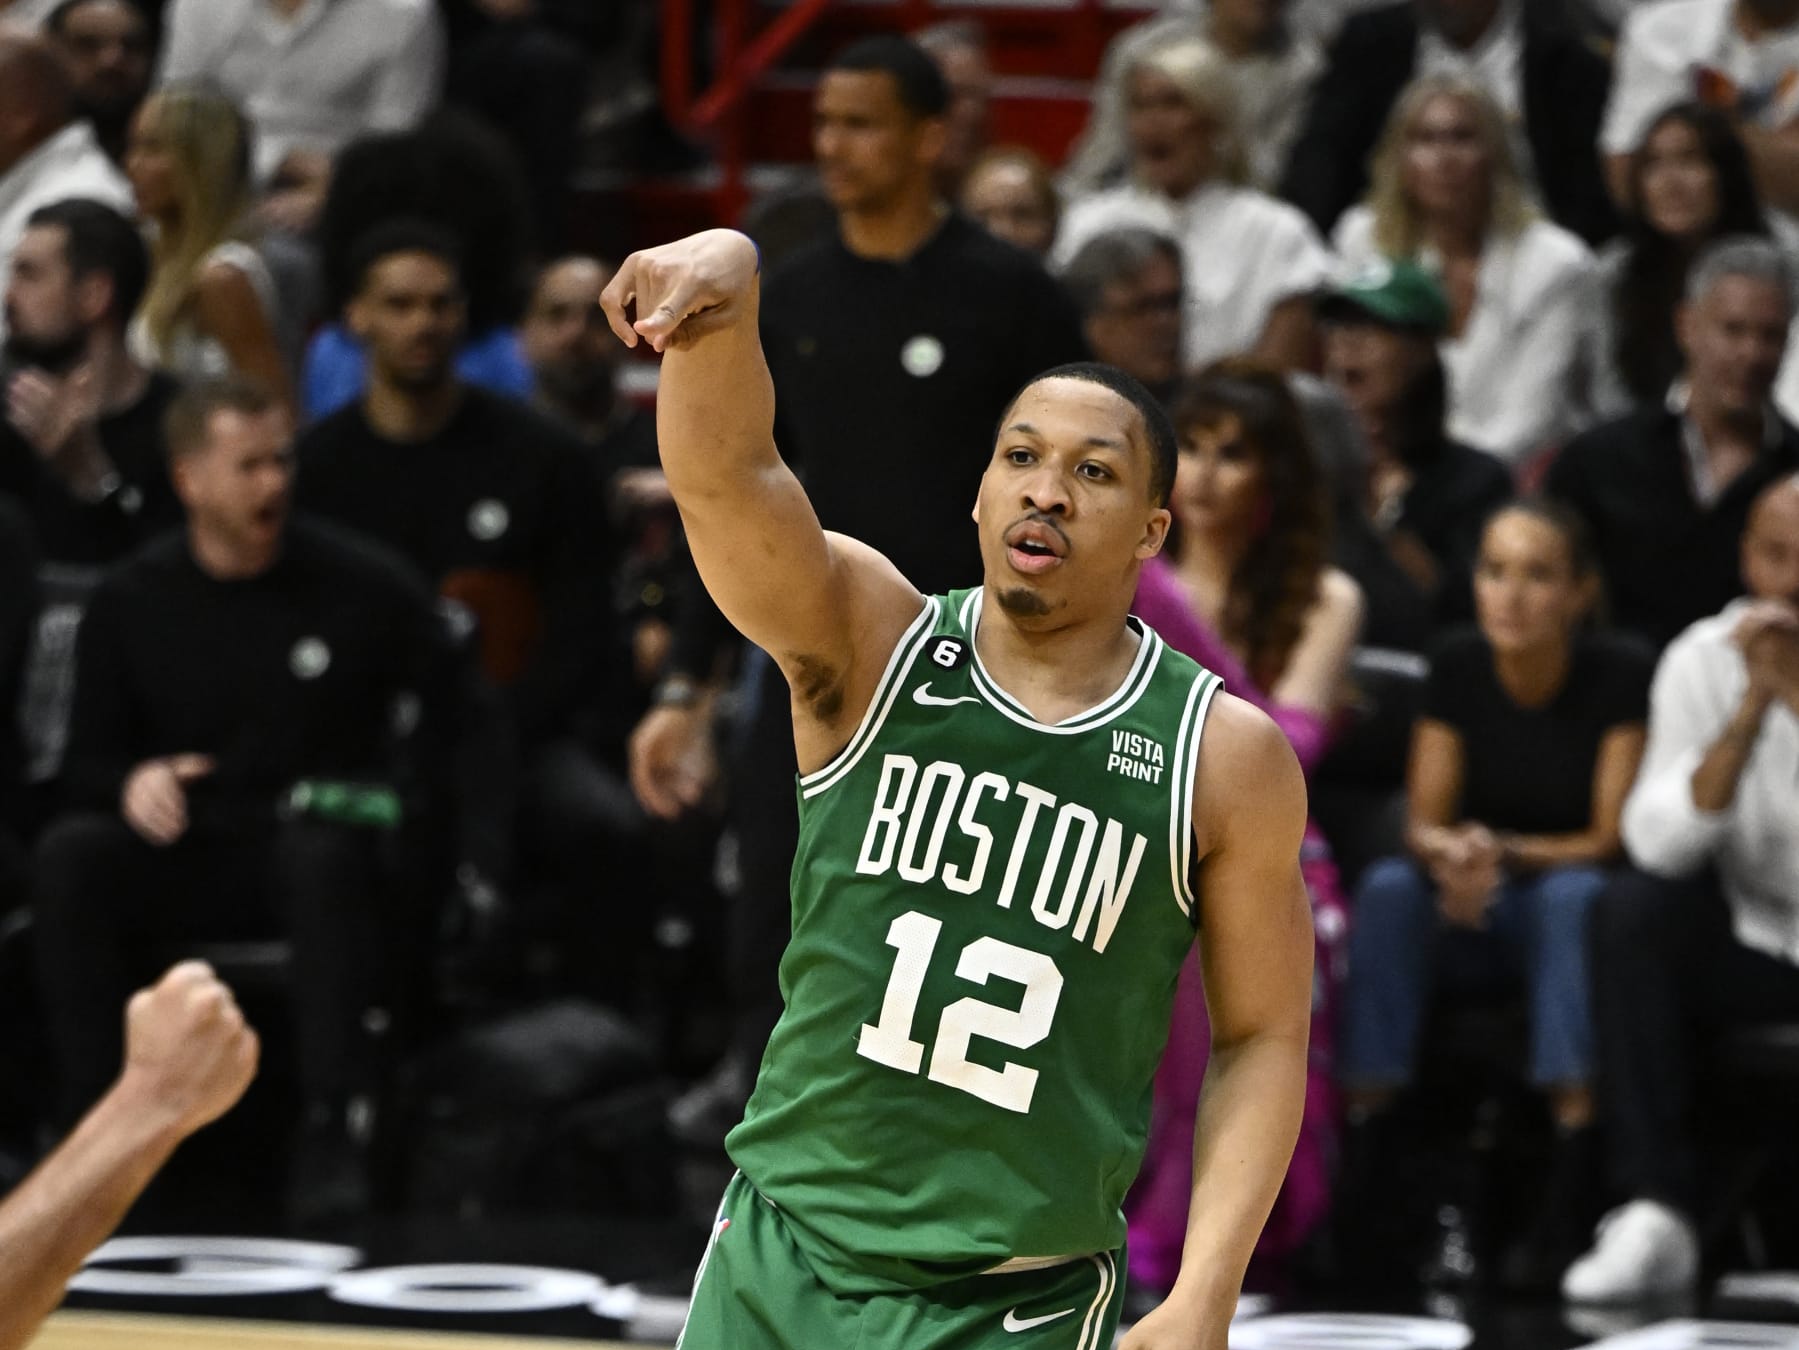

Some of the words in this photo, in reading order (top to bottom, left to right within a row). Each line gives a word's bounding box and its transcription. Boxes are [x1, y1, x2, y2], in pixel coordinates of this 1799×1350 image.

[933, 640, 962, 667] 6
[1112, 729, 1164, 768] VISTA
[1106, 752, 1164, 785] PRINT
[855, 754, 1148, 954] BOSTON
[856, 910, 1064, 1114] 12
